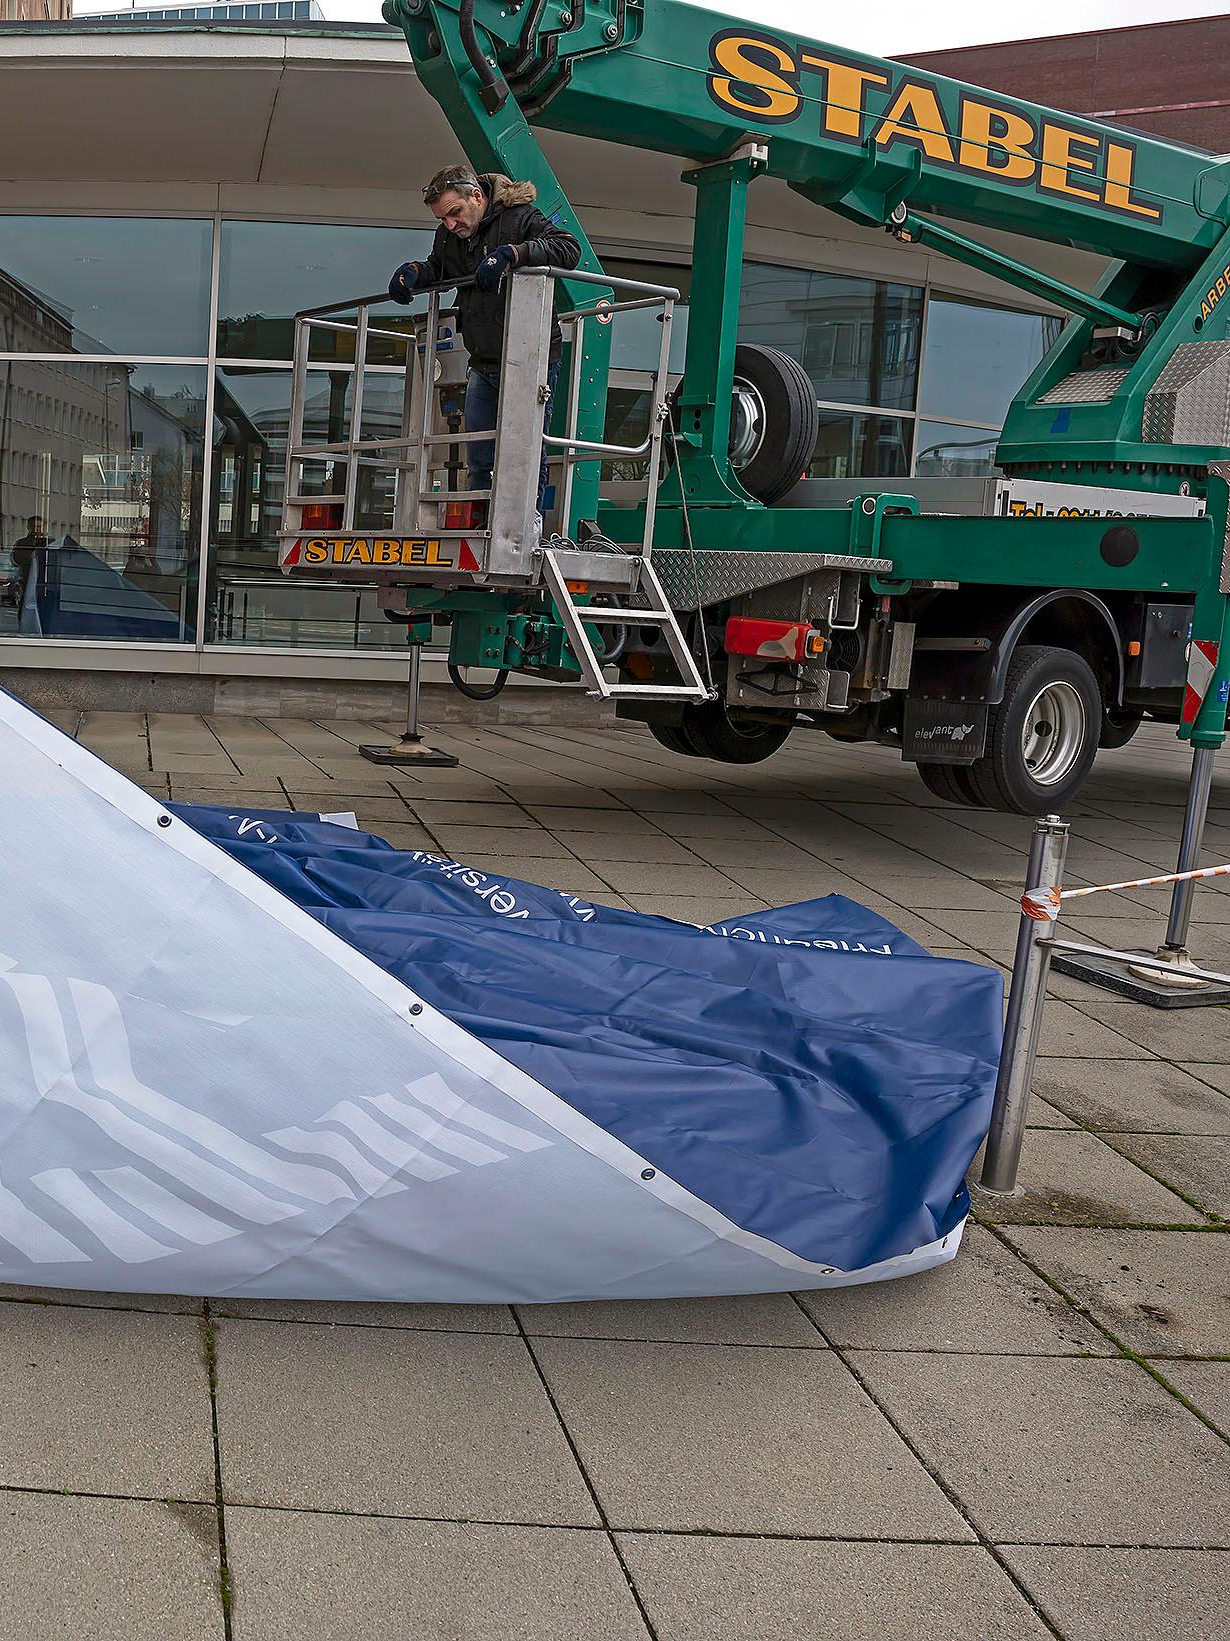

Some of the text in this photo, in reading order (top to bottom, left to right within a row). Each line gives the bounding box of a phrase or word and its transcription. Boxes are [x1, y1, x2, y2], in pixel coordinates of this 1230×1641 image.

[707, 30, 1163, 222] STABEL
[305, 538, 452, 566] STABEL
[914, 725, 955, 739] elevant
